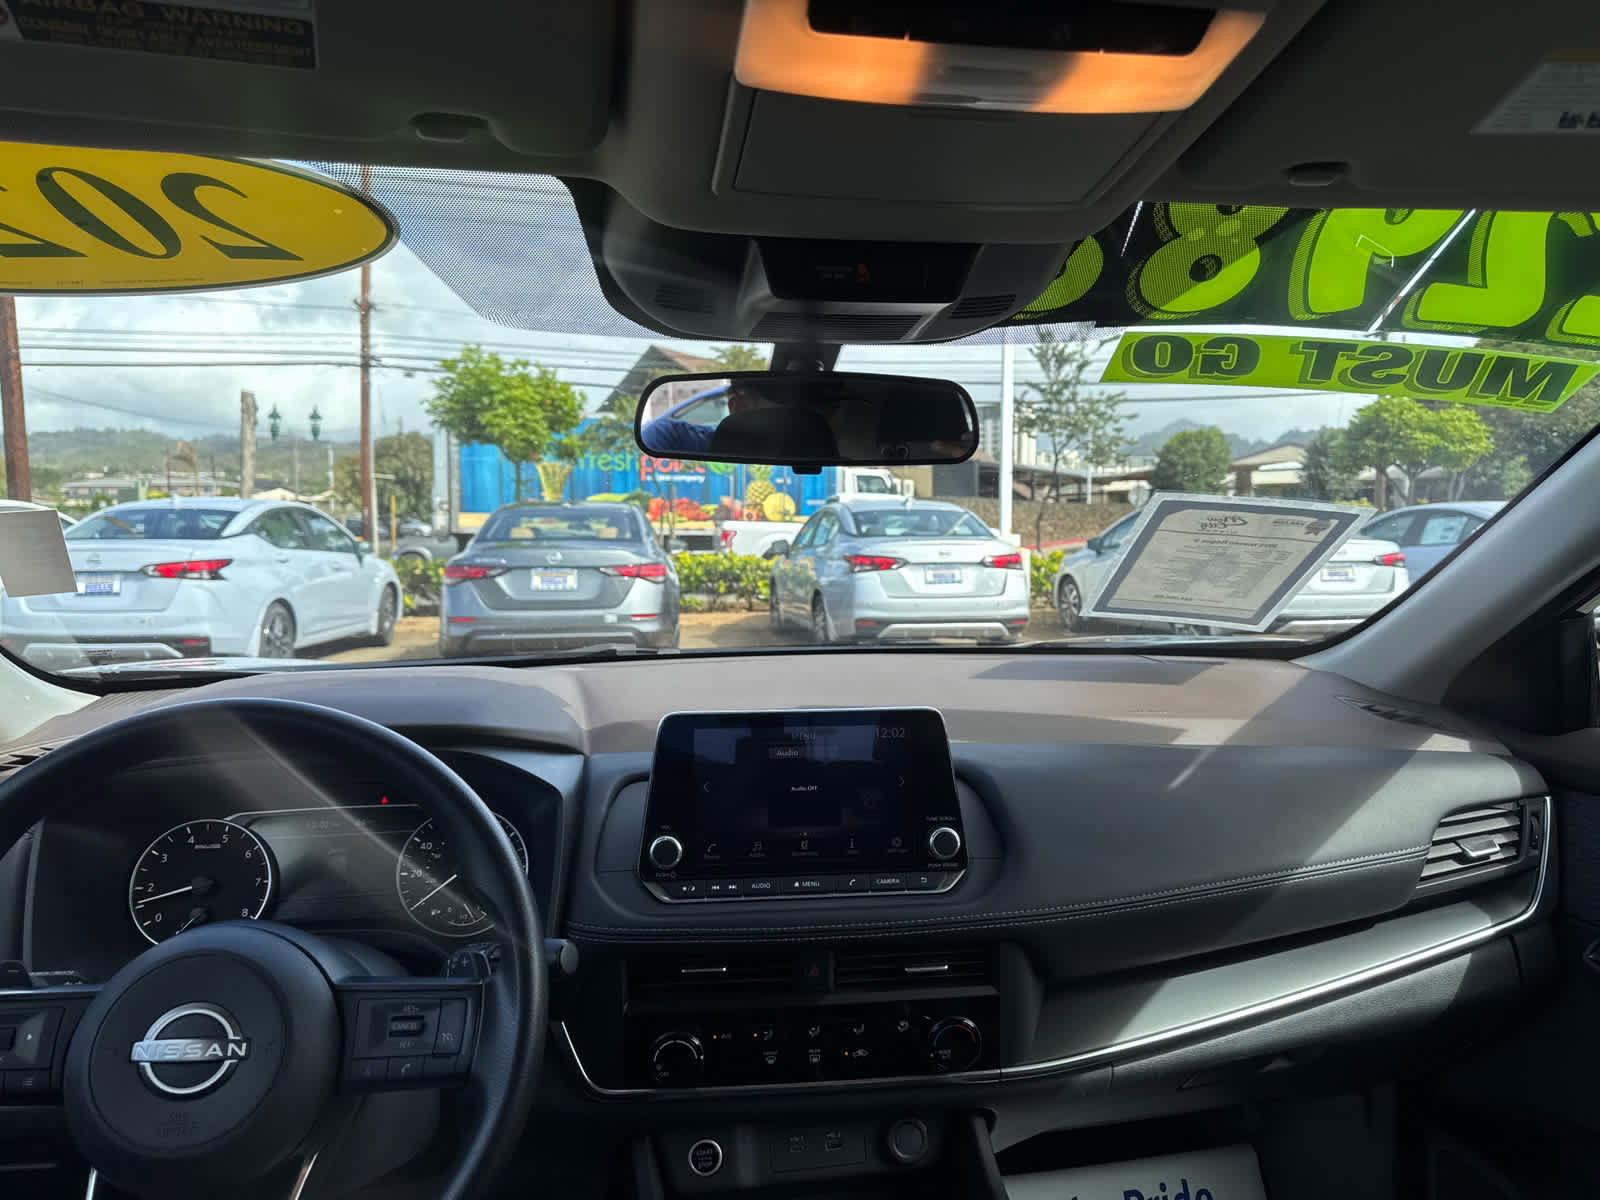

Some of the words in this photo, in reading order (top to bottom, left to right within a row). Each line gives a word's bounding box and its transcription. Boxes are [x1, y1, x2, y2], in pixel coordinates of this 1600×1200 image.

[160, 7, 305, 36] WARNING
[875, 727, 905, 739] 12:02
[801, 880, 820, 888] MENU
[132, 1041, 248, 1060] NISSAN
